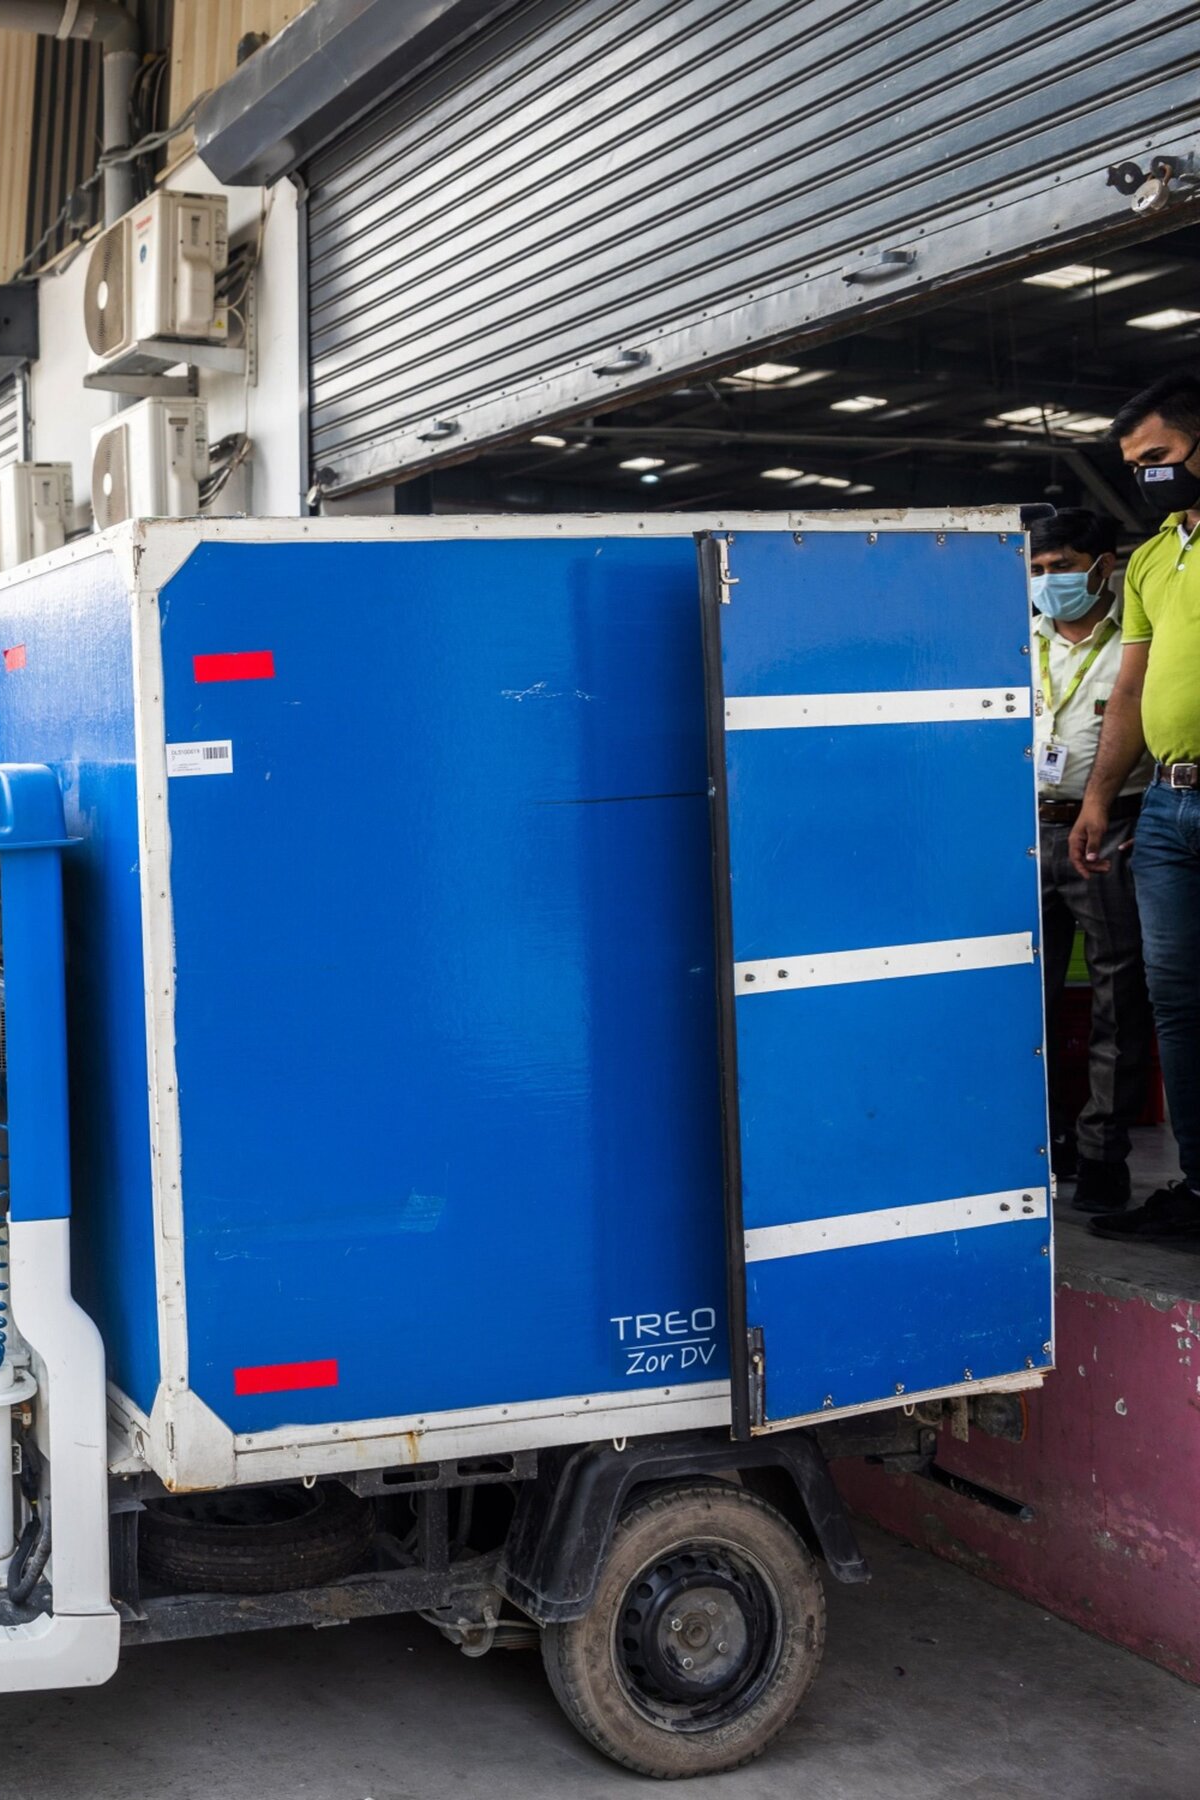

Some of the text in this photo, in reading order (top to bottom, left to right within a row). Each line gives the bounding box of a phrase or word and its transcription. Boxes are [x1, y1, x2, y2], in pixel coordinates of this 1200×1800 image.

[610, 1307, 716, 1341] TREO
[625, 1343, 717, 1375] Zor DV
